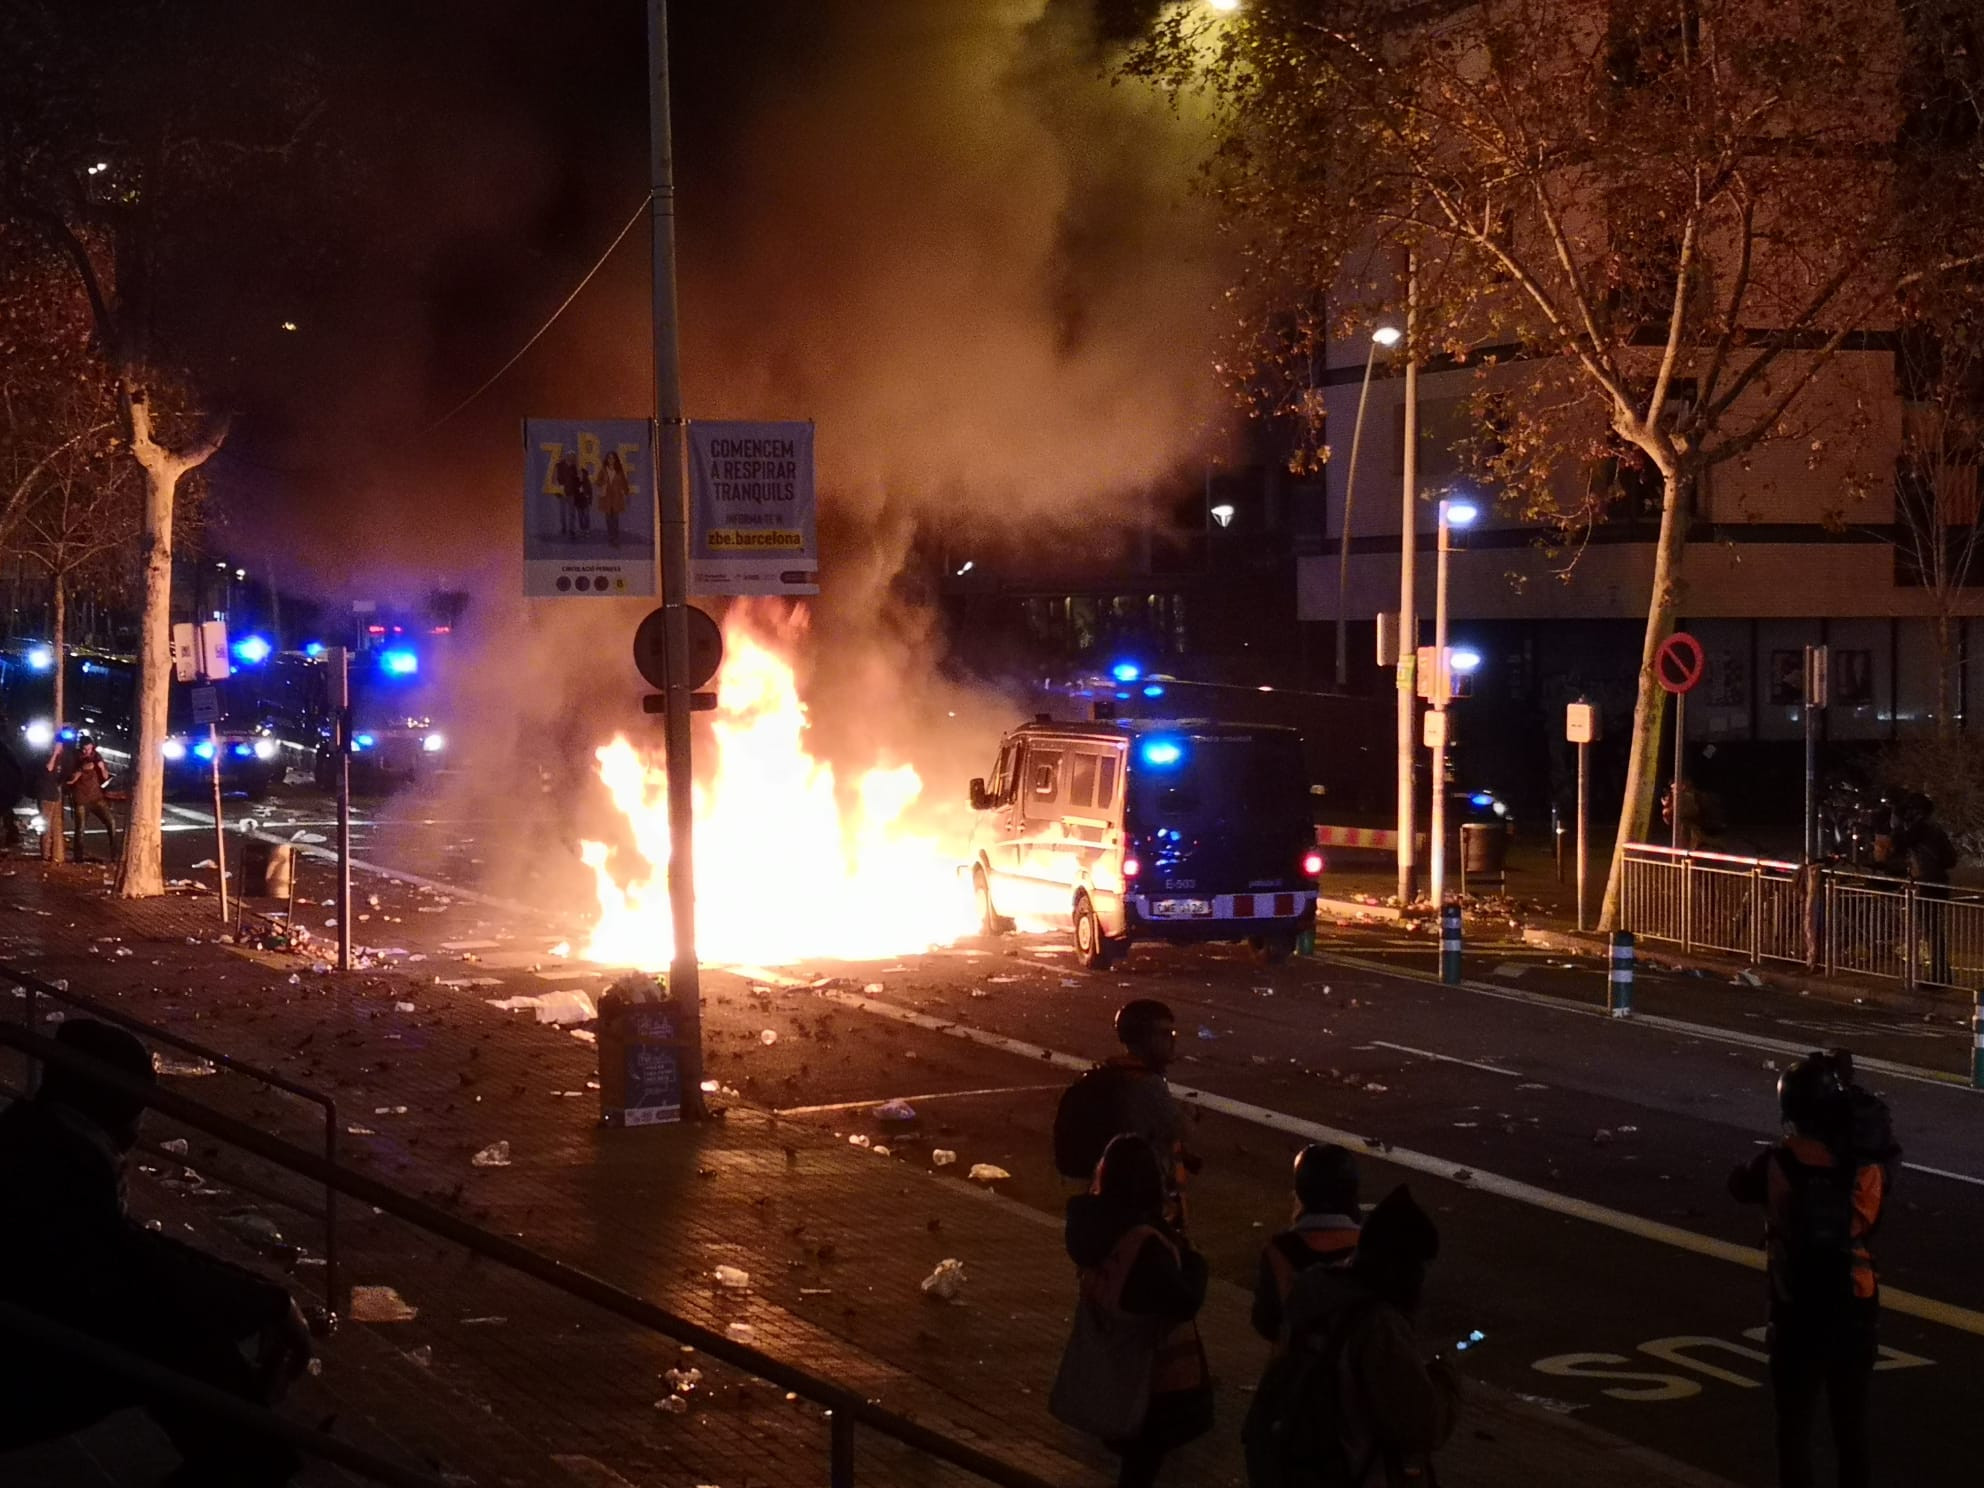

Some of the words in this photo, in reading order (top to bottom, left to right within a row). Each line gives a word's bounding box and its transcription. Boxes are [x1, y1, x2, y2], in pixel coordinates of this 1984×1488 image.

[711, 439, 794, 458] COMENCEM
[540, 432, 640, 496] ZBE
[724, 461, 796, 480] RESPIRAR
[713, 482, 794, 505] TRANQUILS
[708, 531, 799, 544] zbe.barcelona
